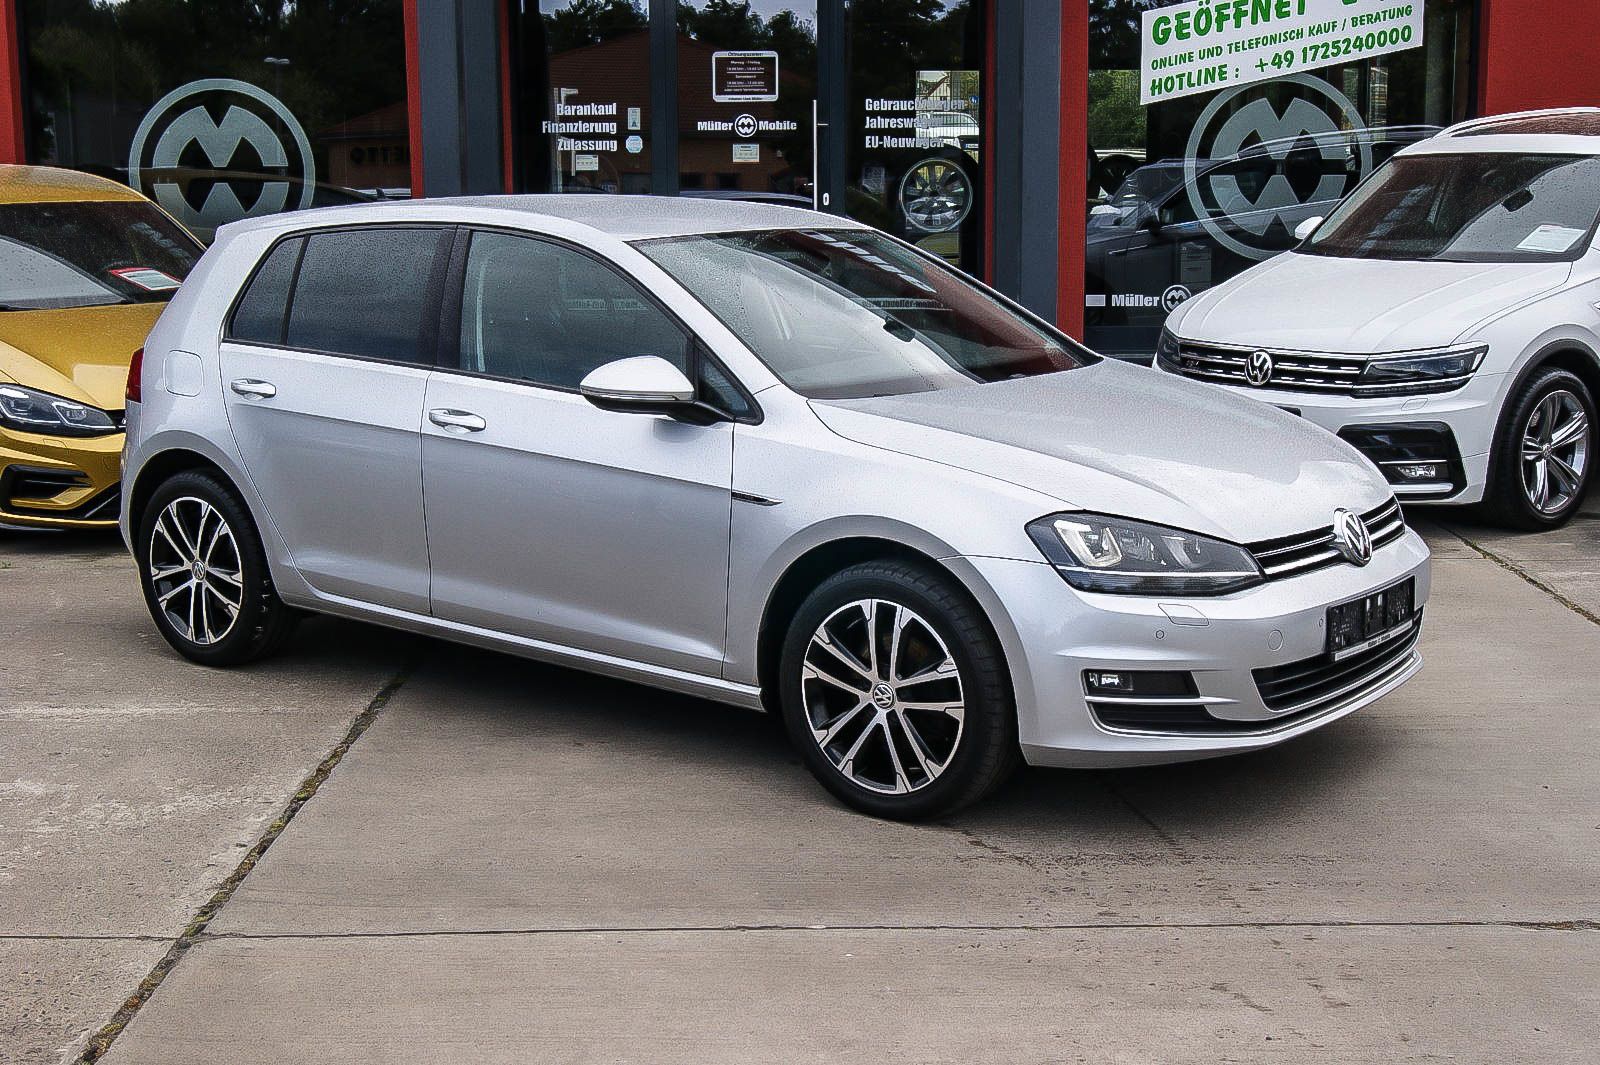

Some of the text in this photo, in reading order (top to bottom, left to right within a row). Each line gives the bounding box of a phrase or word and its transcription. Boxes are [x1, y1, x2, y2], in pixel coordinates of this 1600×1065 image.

[1151, 5, 1413, 71] ONLINE UND TELEFONISCH KAUF / BERATUNG
[1150, 63, 1228, 97] HOTLINE
[1254, 49, 1294, 73] +49
[1301, 25, 1412, 65] 1725240000
[865, 98, 964, 112] Gebrauchgen
[542, 120, 617, 134] Finanzierung
[697, 120, 733, 131] Müller
[758, 120, 798, 131] Mobile
[865, 115, 945, 130] Jahreswag
[557, 138, 618, 152] Zulassung
[1111, 293, 1160, 307] Müller
